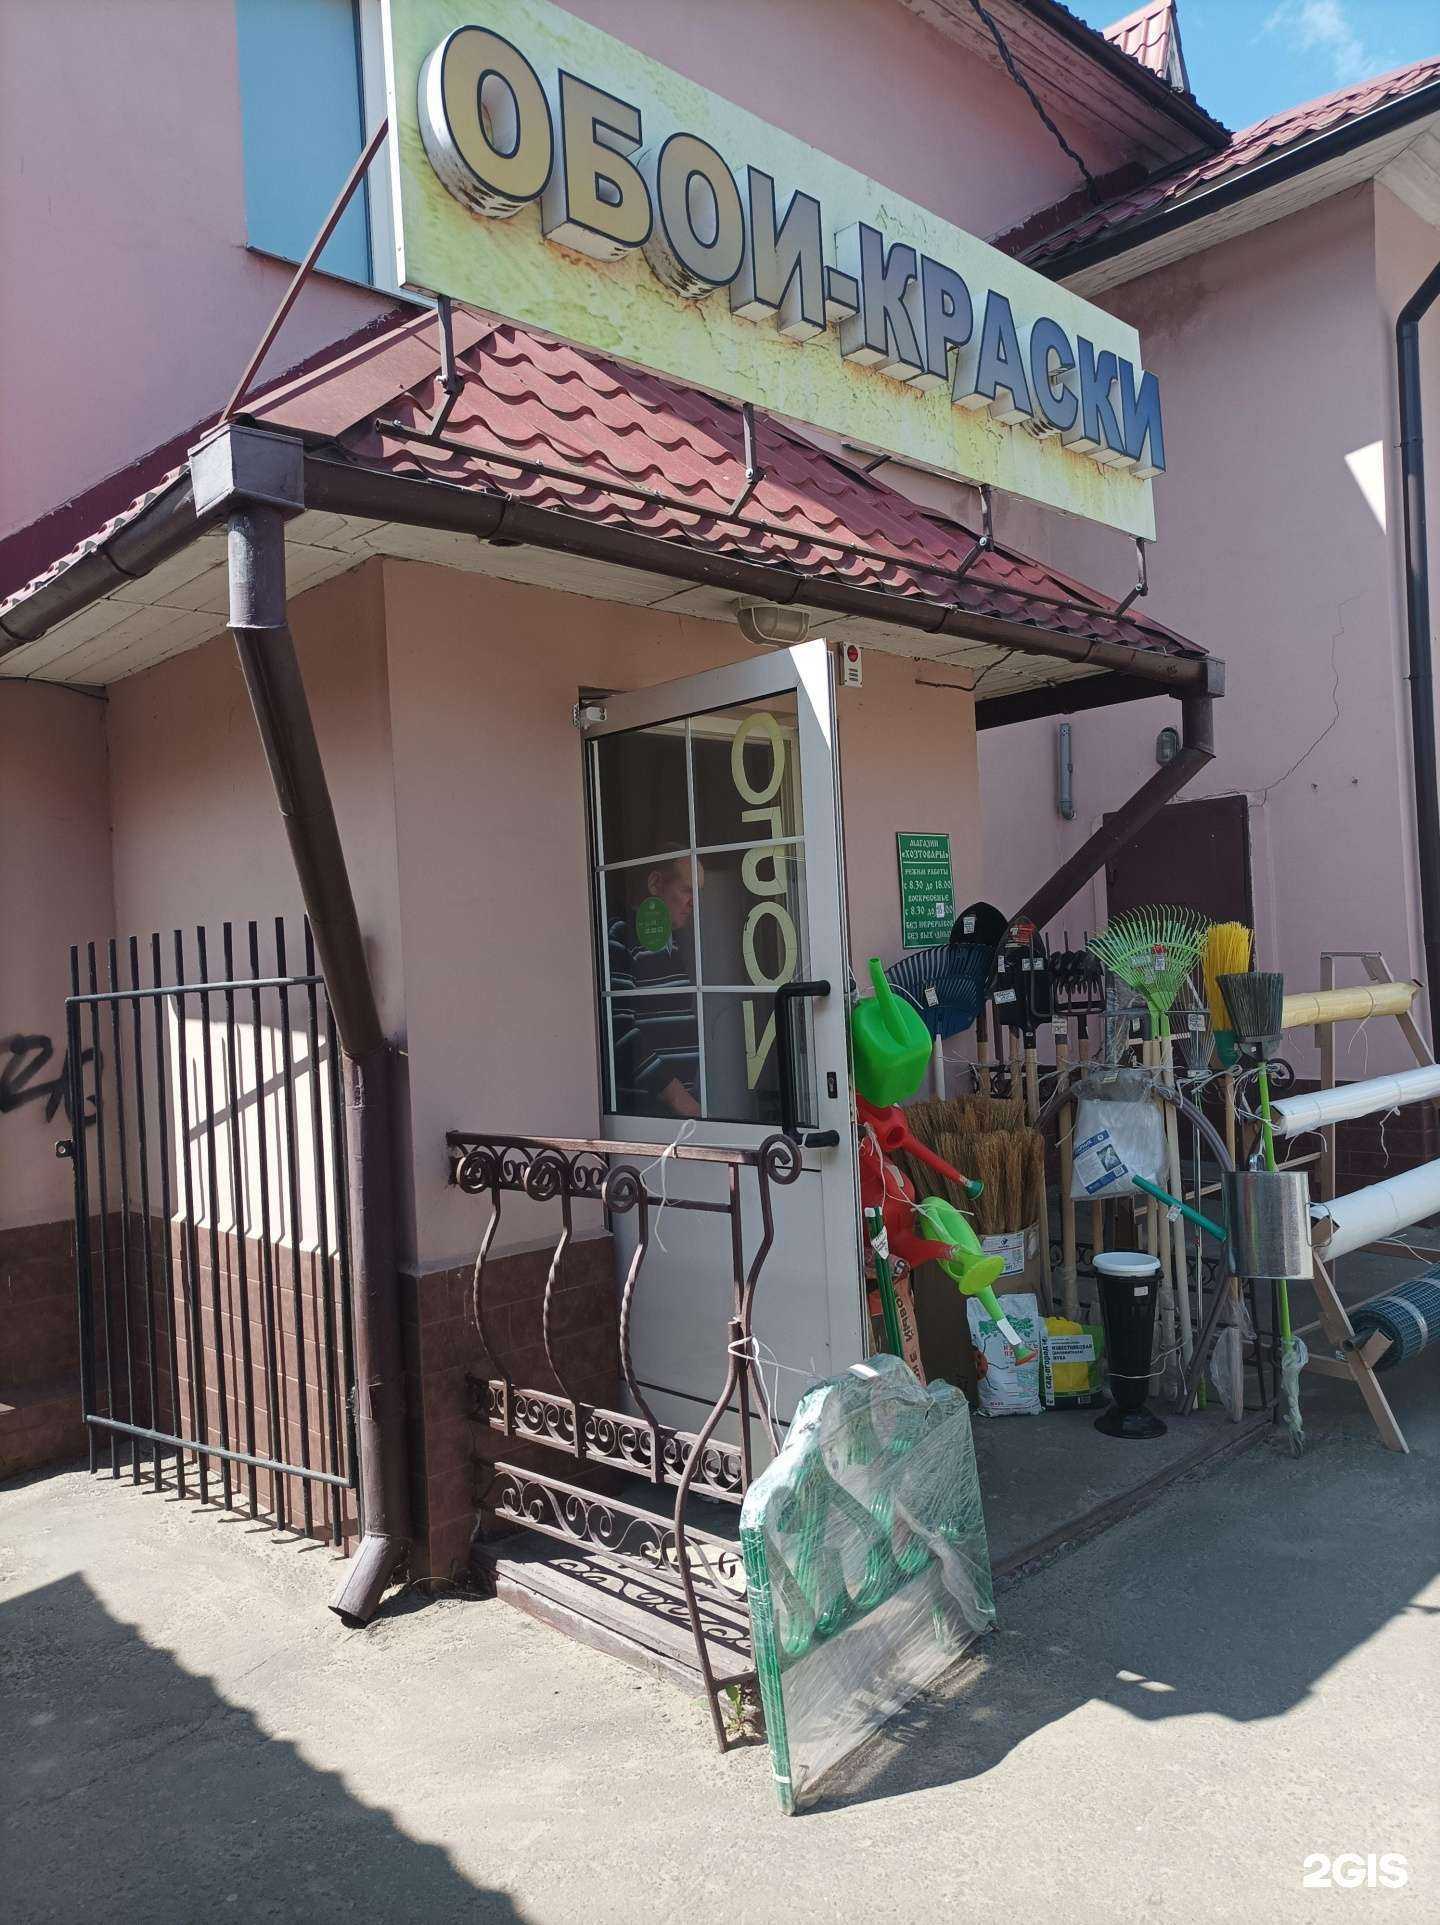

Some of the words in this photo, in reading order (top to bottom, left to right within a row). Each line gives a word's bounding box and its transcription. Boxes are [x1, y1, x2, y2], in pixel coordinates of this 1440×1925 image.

[418, 25, 1166, 480] ОБОИ-КРАСКИ
[909, 839, 939, 848] МАГАЗИН
[928, 868, 949, 876] РАБОТЫ
[909, 880, 924, 890] 8.30
